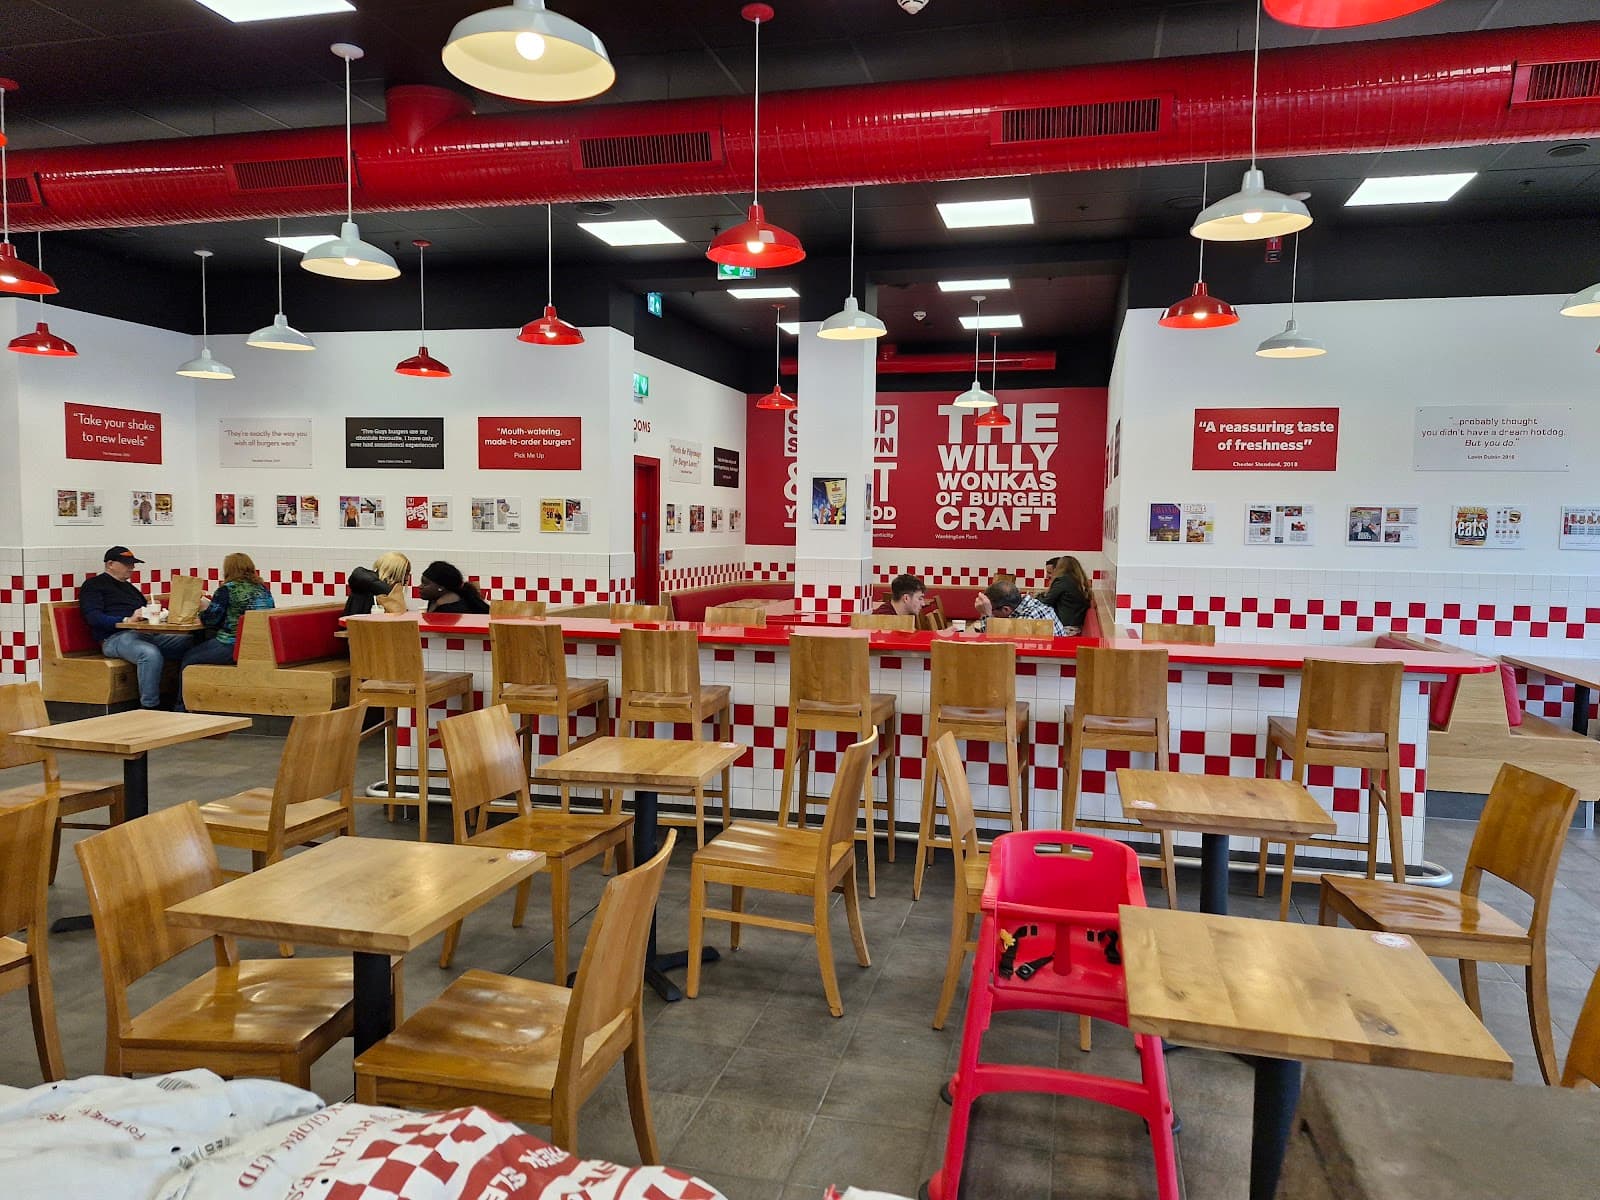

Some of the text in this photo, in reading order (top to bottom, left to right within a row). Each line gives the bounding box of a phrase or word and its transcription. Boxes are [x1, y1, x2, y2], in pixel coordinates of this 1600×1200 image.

[103, 418, 126, 430] your
[127, 418, 156, 432] shake
[937, 402, 1060, 444] THE
[1199, 420, 1335, 435] "A reassuring taste
[1501, 417, 1538, 427] thought
[82, 431, 94, 442] to
[95, 435, 116, 443] new
[1439, 428, 1465, 436] didn't
[1498, 428, 1529, 436] dream
[484, 438, 541, 446] made-to-order
[1217, 440, 1233, 451] of
[1464, 439, 1482, 447] But
[1483, 441, 1501, 449] you
[536, 452, 545, 460] Up
[937, 444, 1058, 471] WILLY
[936, 471, 1057, 491] WONKAS
[935, 491, 1057, 507] OF BURGER
[935, 506, 1057, 532] CRAFT
[1457, 519, 1486, 537] eats
